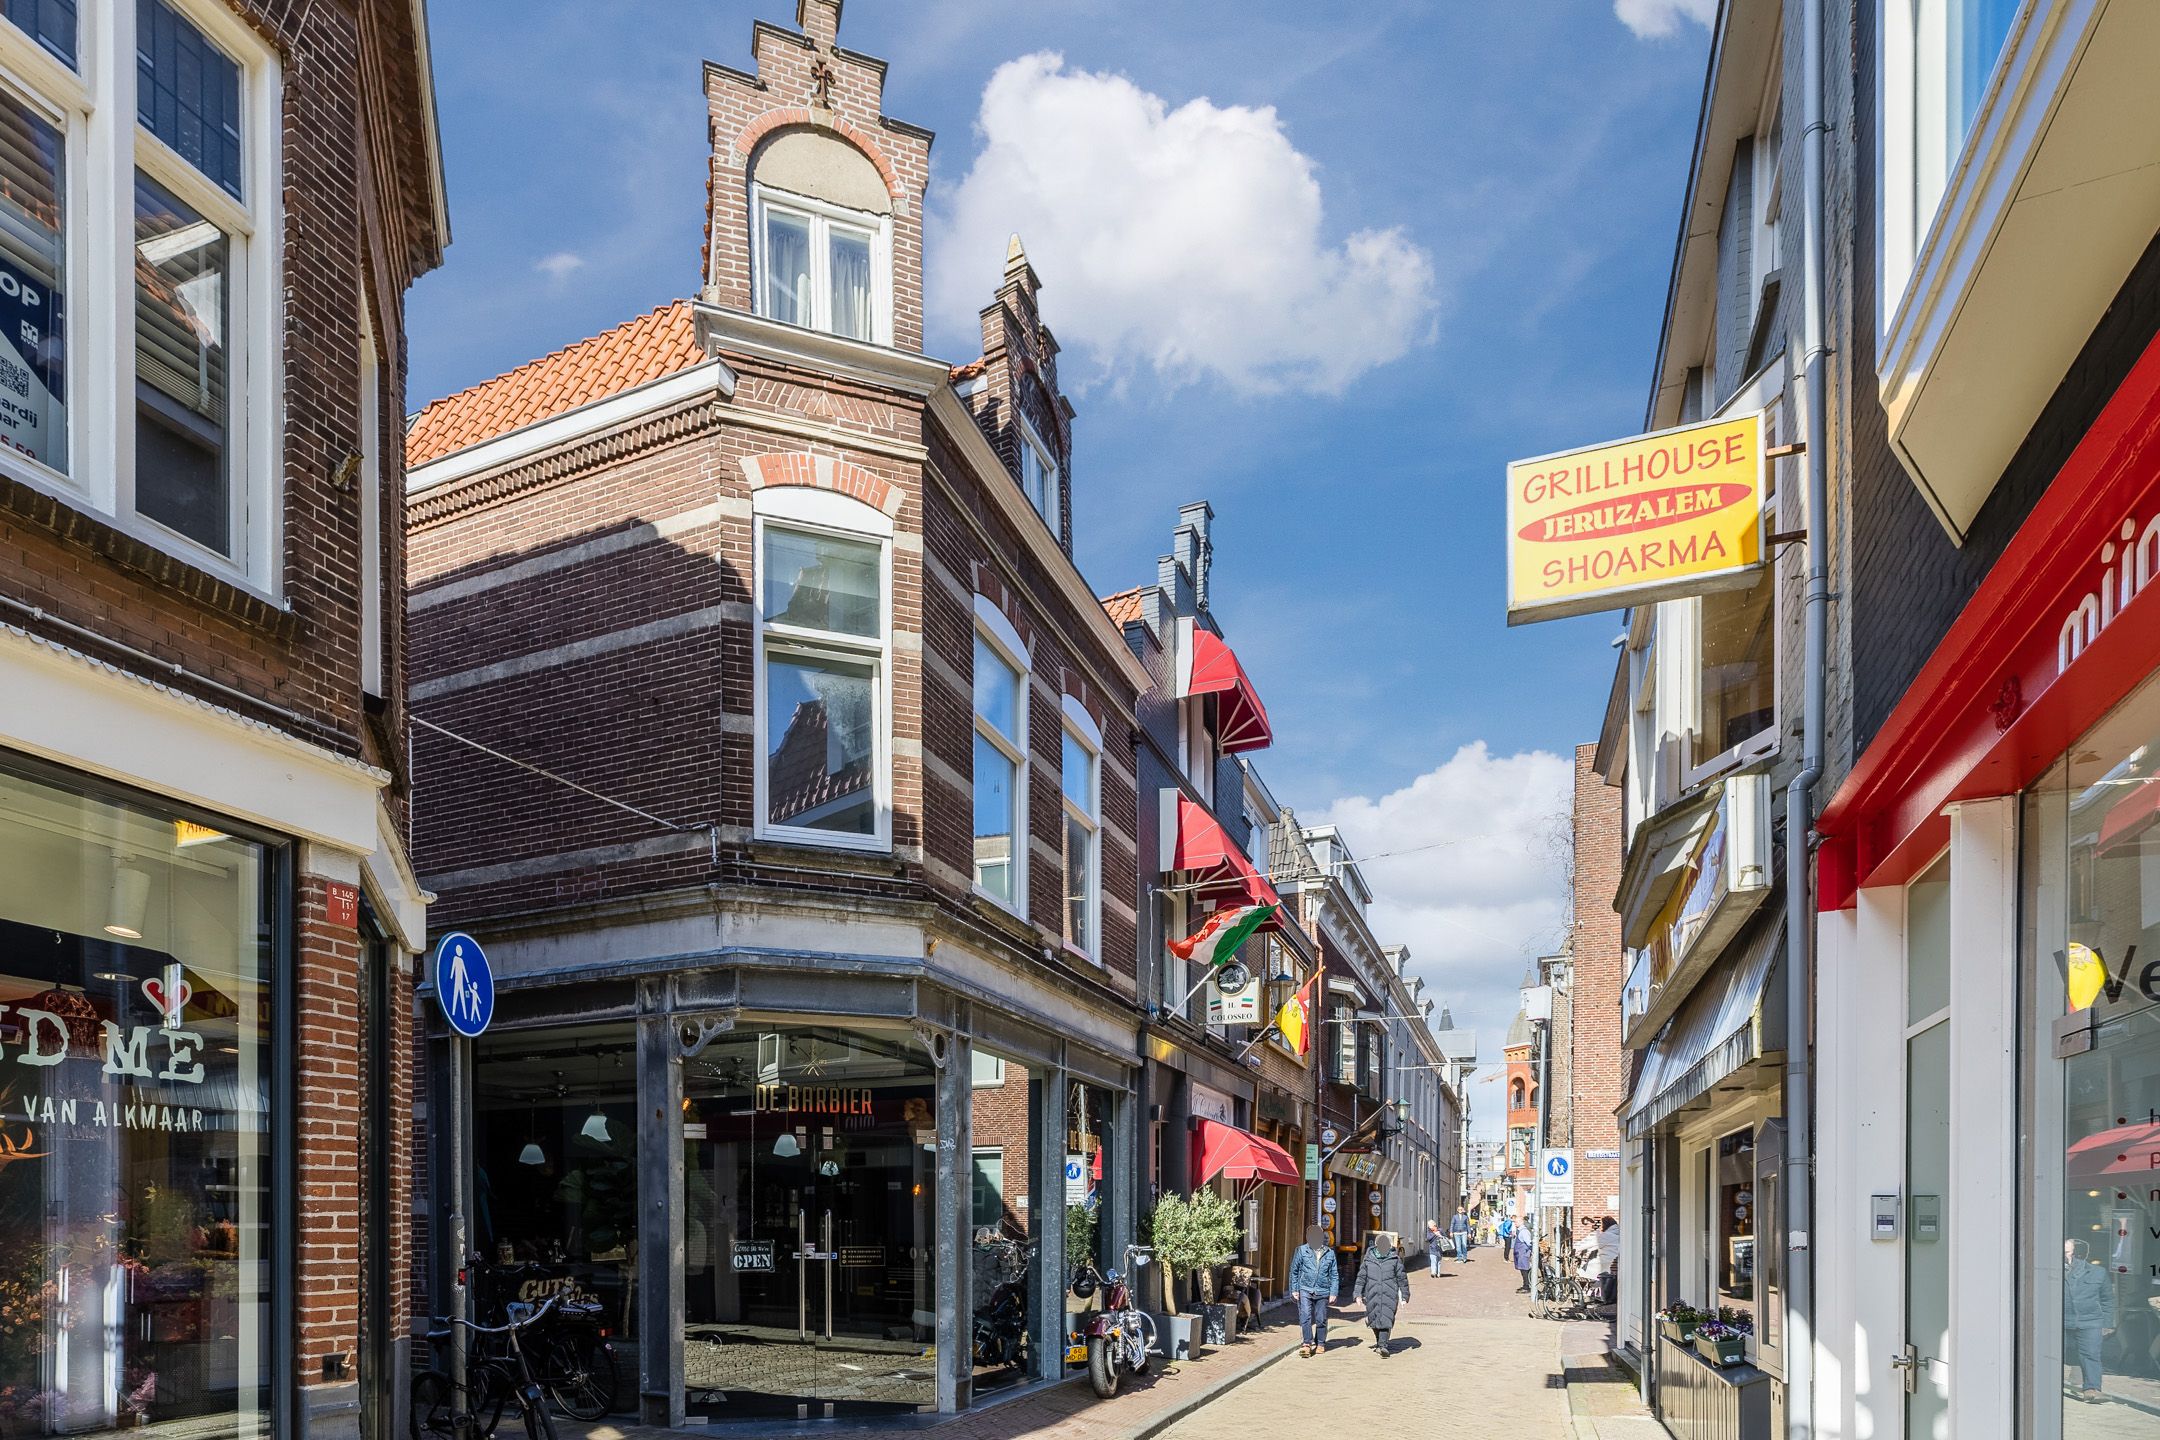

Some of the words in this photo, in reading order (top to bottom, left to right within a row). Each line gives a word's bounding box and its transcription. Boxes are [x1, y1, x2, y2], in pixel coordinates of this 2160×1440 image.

[0, 397, 38, 429] ardij
[0, 411, 20, 430] aar
[1523, 433, 1746, 504] GRILLHOUSE
[1542, 486, 1723, 540] JERUZALEM
[1543, 530, 1726, 588] SHOARMA
[342, 912, 350, 920] 17
[1211, 1013, 1253, 1022] COLOSSEO
[100, 1019, 205, 1084] ME
[23, 1095, 77, 1126] VAN
[92, 1101, 203, 1133] ALKMAAR
[756, 1084, 780, 1111] DE
[788, 1085, 873, 1115] BARBIER
[733, 1254, 771, 1269] OPEN
[518, 1276, 575, 1303] CUTS
